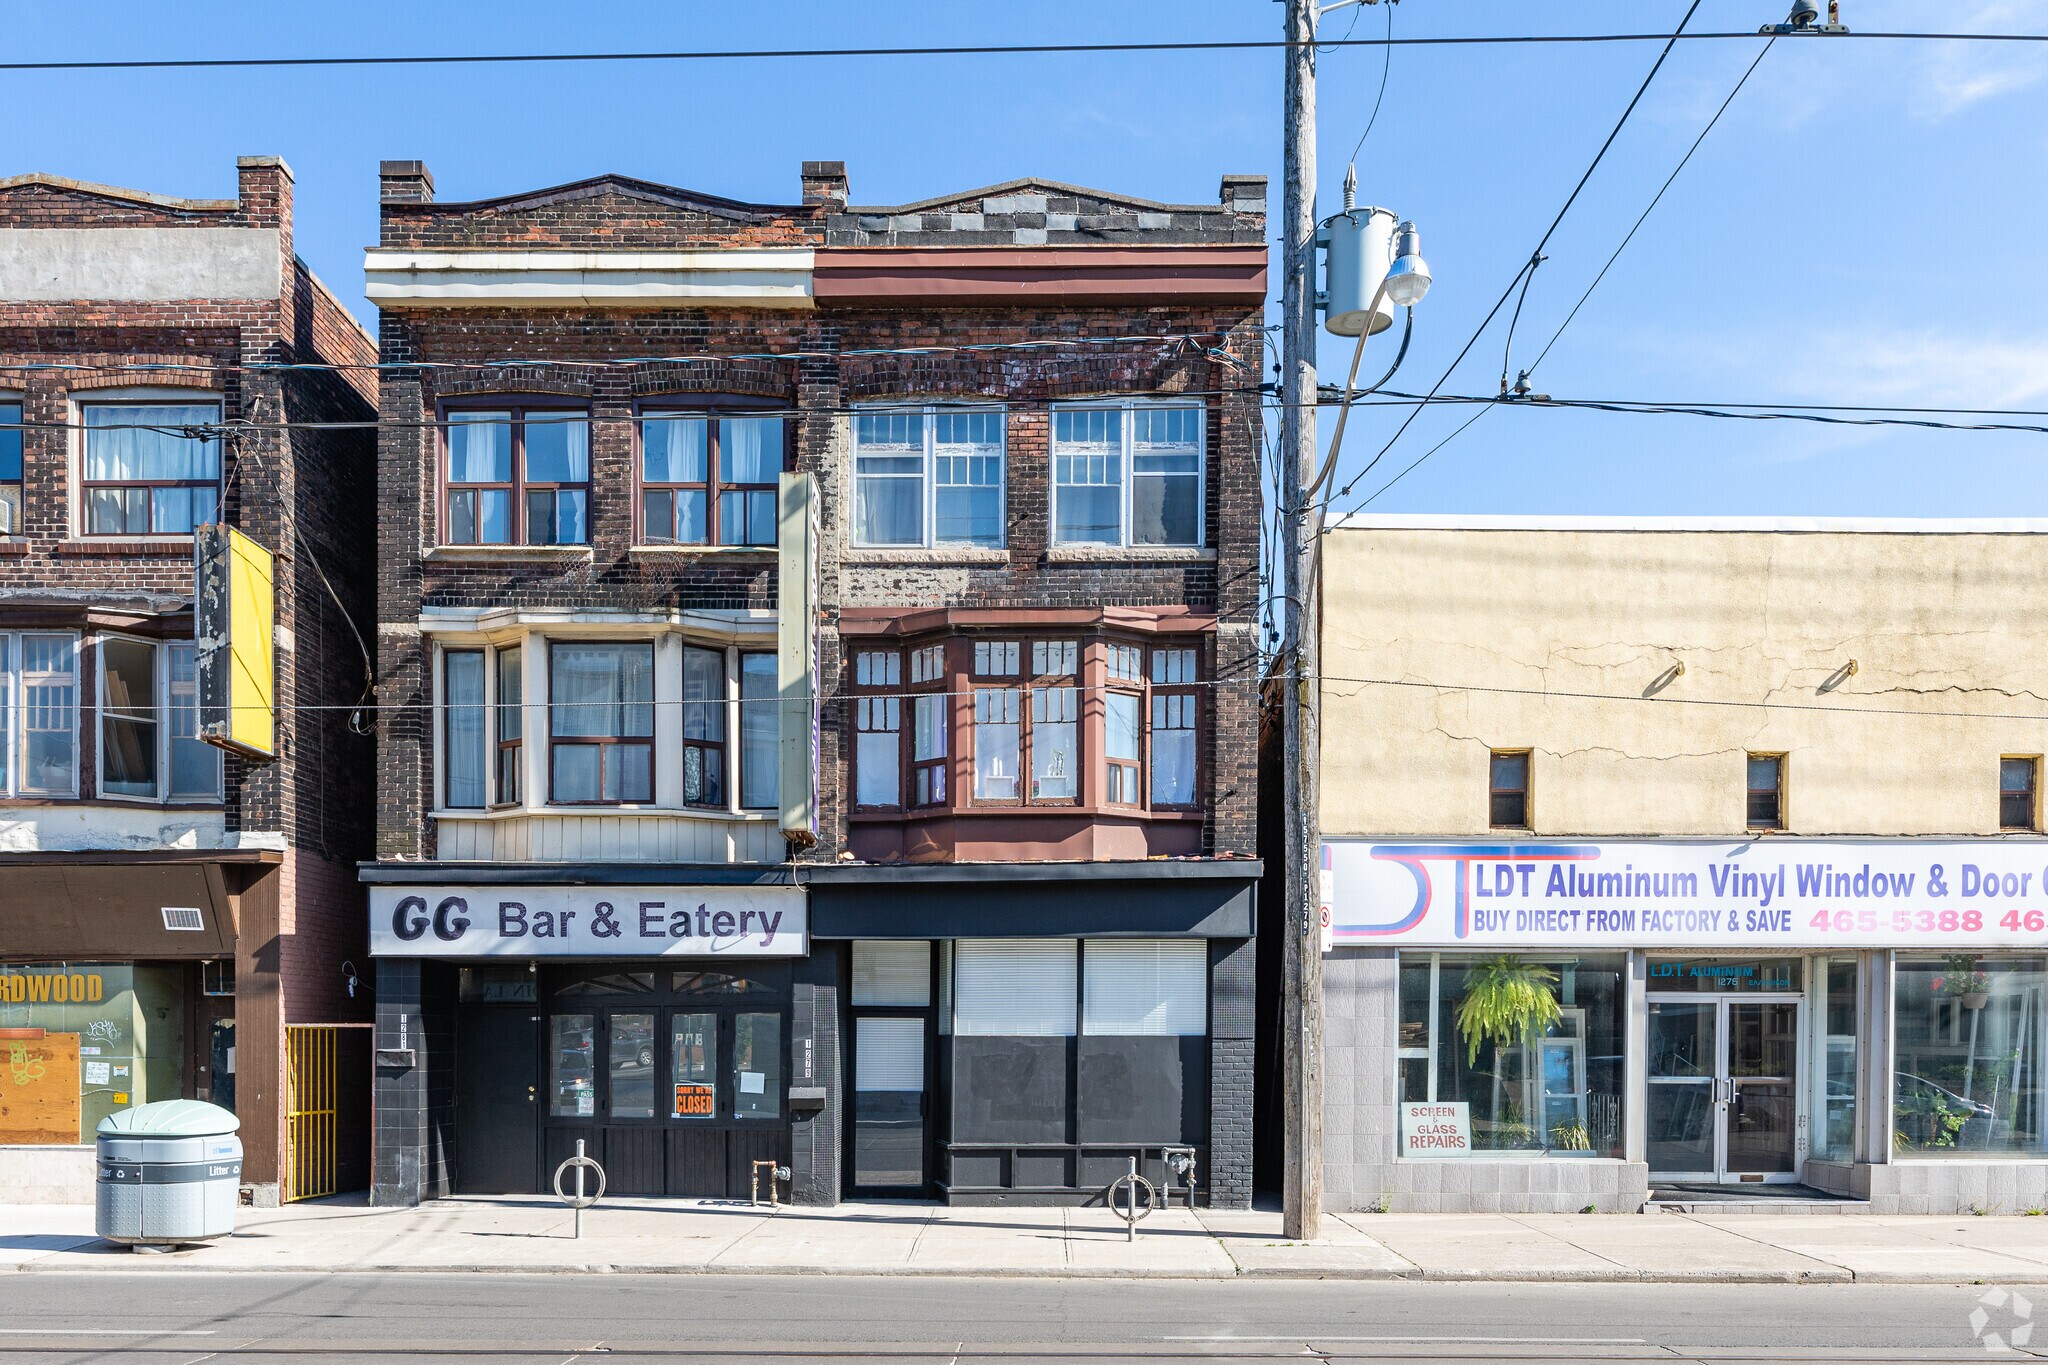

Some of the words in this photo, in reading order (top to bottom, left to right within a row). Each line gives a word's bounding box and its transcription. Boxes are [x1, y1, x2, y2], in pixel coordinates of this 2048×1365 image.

[1476, 863, 1536, 898] LDT
[1545, 863, 1698, 898] Aluminum
[1709, 863, 1785, 907] Vinyl
[1796, 863, 1916, 898] Window
[1926, 863, 1949, 898] &
[1961, 863, 2033, 898] Door
[391, 895, 472, 942] GG
[498, 901, 577, 938] Bar
[590, 901, 622, 938] &
[638, 901, 784, 948] Eatery
[1474, 909, 1512, 932] BUY
[1516, 909, 1581, 932] DIRECT
[1586, 909, 1635, 932] FROM
[1642, 909, 1721, 932] FACTORY
[1727, 909, 1740, 932] &
[1745, 909, 1792, 932] SAVE
[1809, 909, 1984, 932] 465-5388
[2000, 909, 2048, 932] 46
[1650, 963, 1684, 977] L.D.T.
[1689, 965, 1753, 977] ALUMINUM
[1717, 977, 1739, 986] 1275
[677, 1086, 694, 1094] SORRY
[695, 1086, 713, 1094] WE'RE
[676, 1095, 713, 1114] CLOSED
[1410, 1107, 1455, 1118] SCREEN
[1417, 1124, 1457, 1135] GLASS
[1409, 1135, 1466, 1149] REPAIRS
[209, 1165, 230, 1177] Litter
